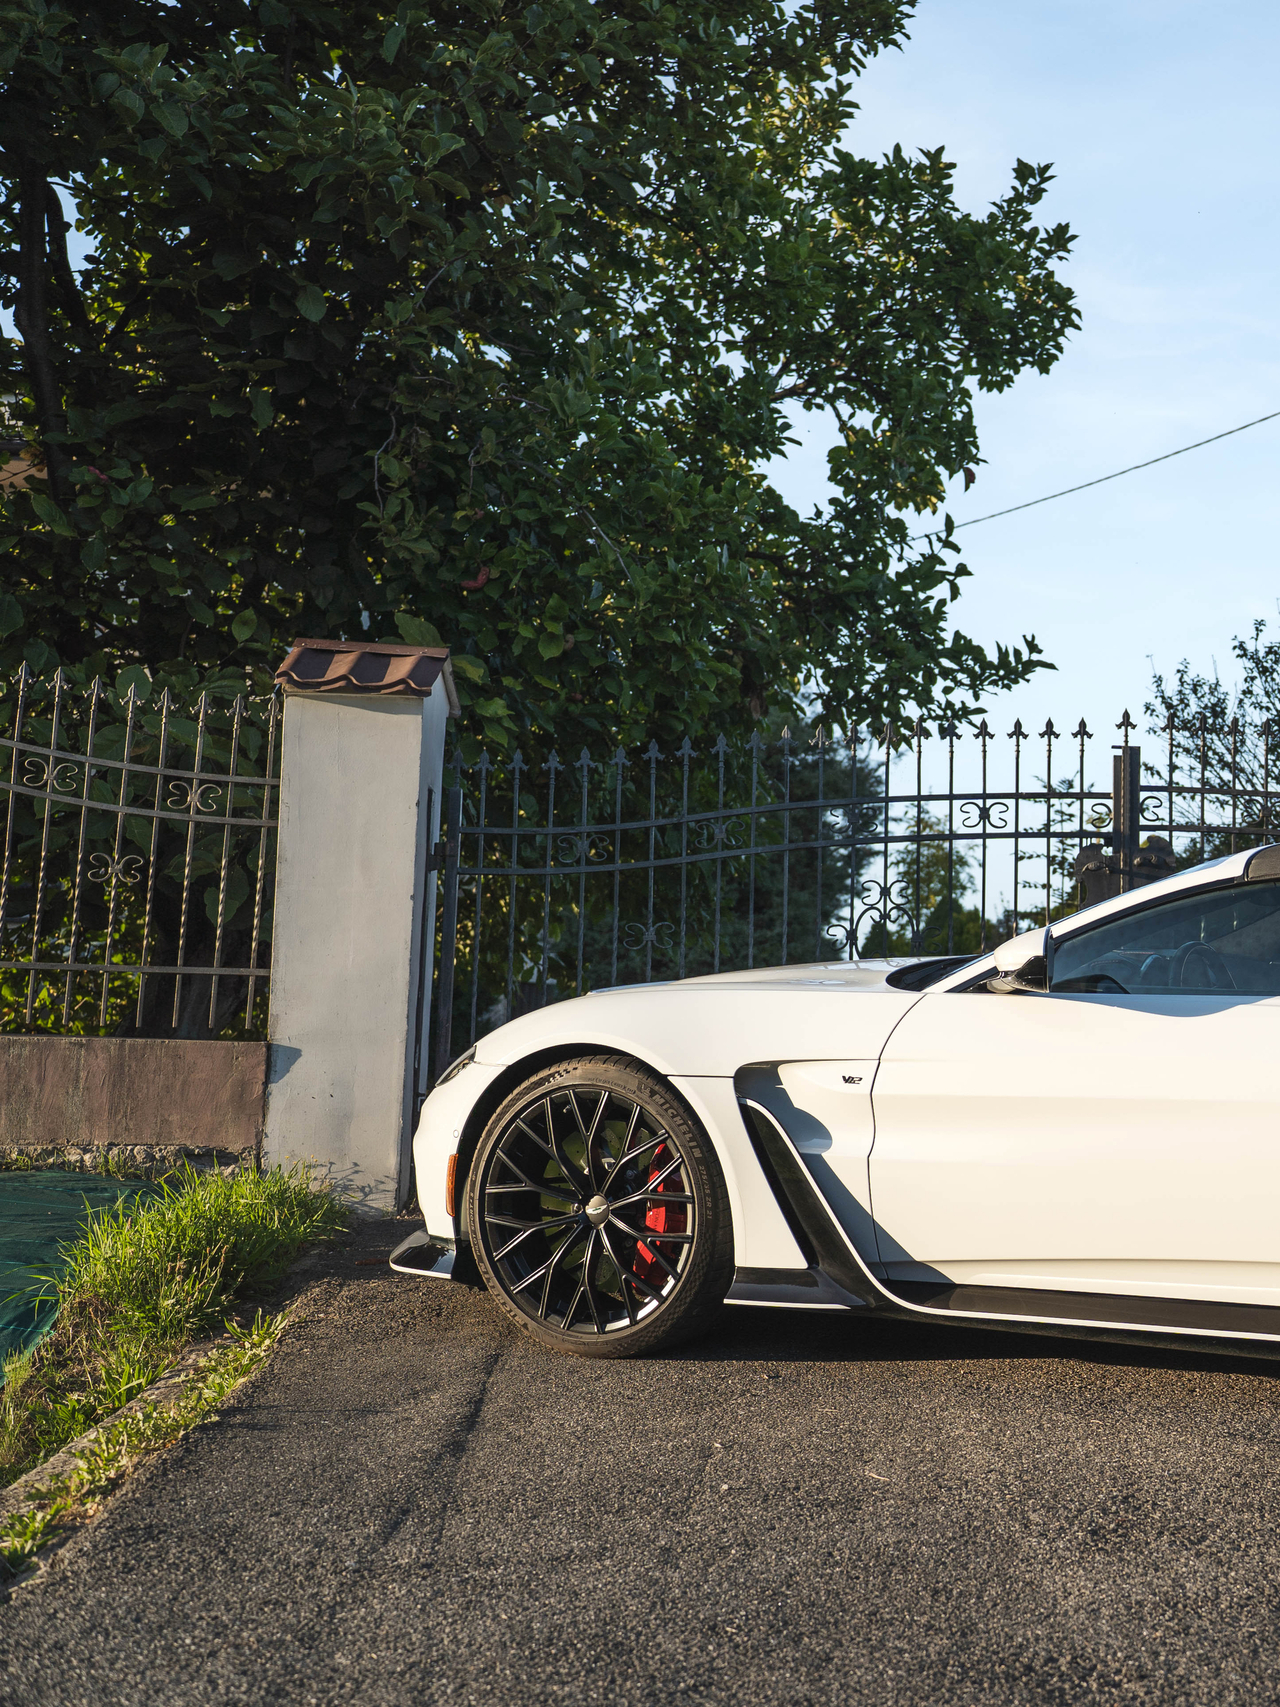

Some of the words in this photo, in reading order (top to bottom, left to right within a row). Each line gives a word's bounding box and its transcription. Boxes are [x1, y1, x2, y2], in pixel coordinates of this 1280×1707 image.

[842, 1075, 863, 1084] V12
[652, 1094, 703, 1158] MICHELIN
[706, 1196, 713, 1208] ZR
[707, 1210, 713, 1219] 21
[479, 1263, 525, 1325] MICHELIN
